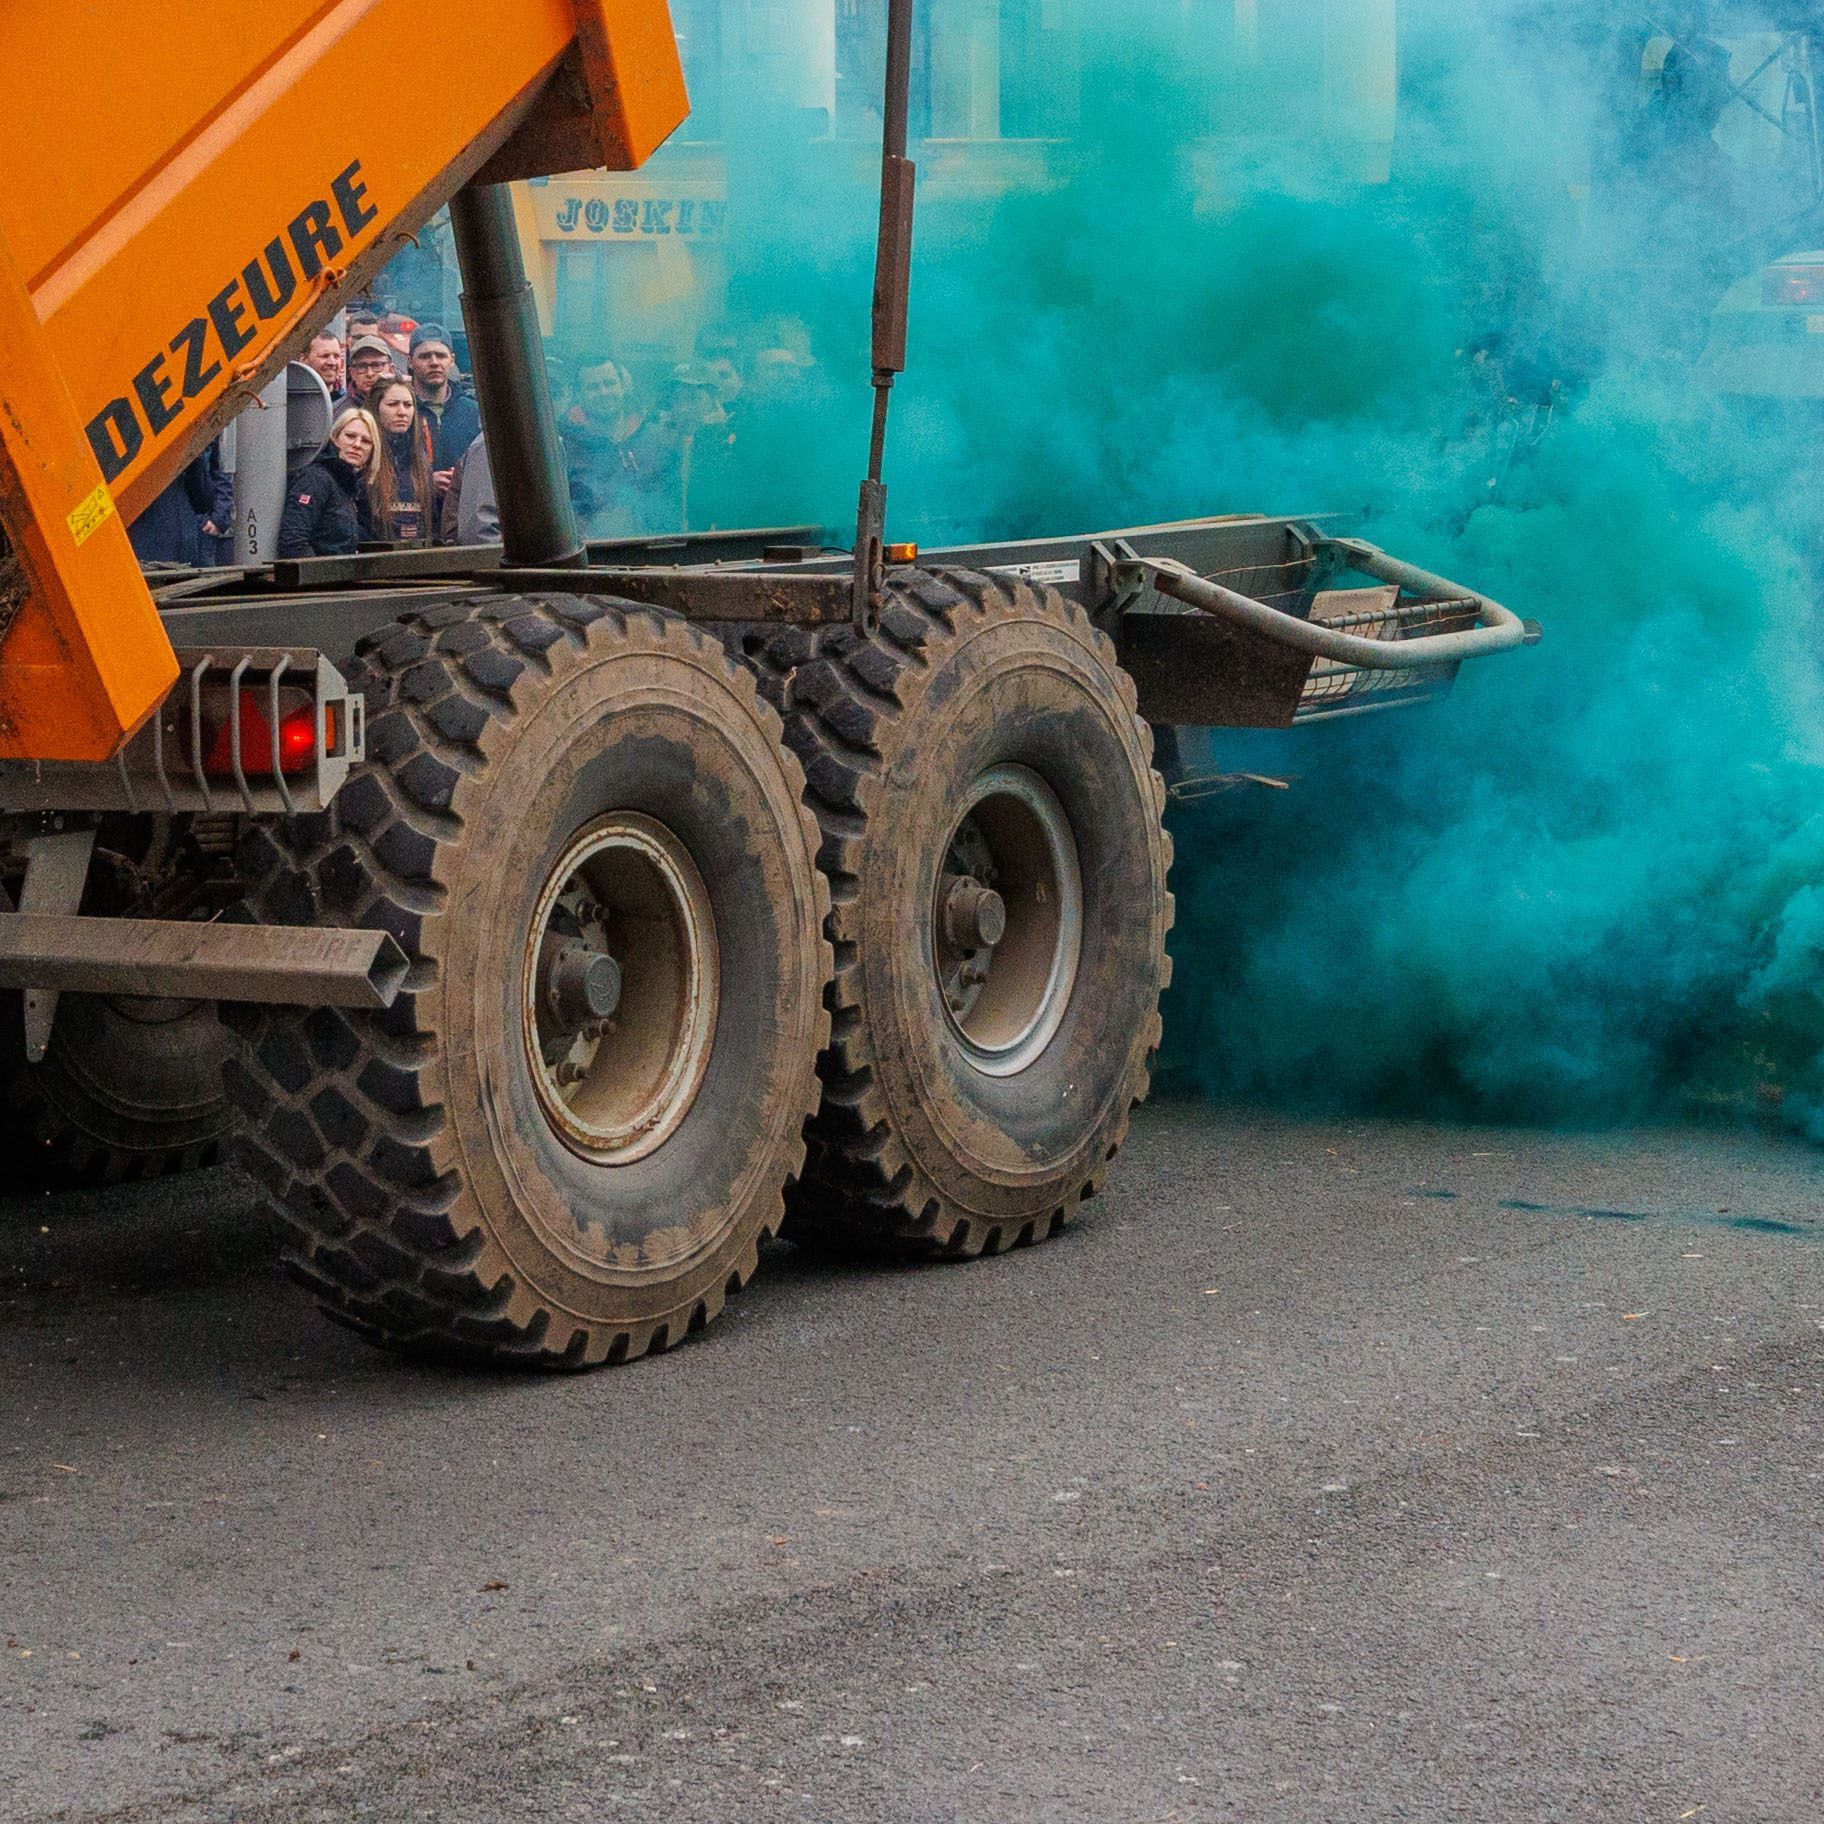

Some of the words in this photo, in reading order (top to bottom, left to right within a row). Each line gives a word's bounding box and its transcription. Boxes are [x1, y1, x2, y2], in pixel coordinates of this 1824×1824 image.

[555, 198, 727, 235] JOSKIN
[84, 158, 378, 484] DEZEURE
[246, 508, 258, 555] A03
